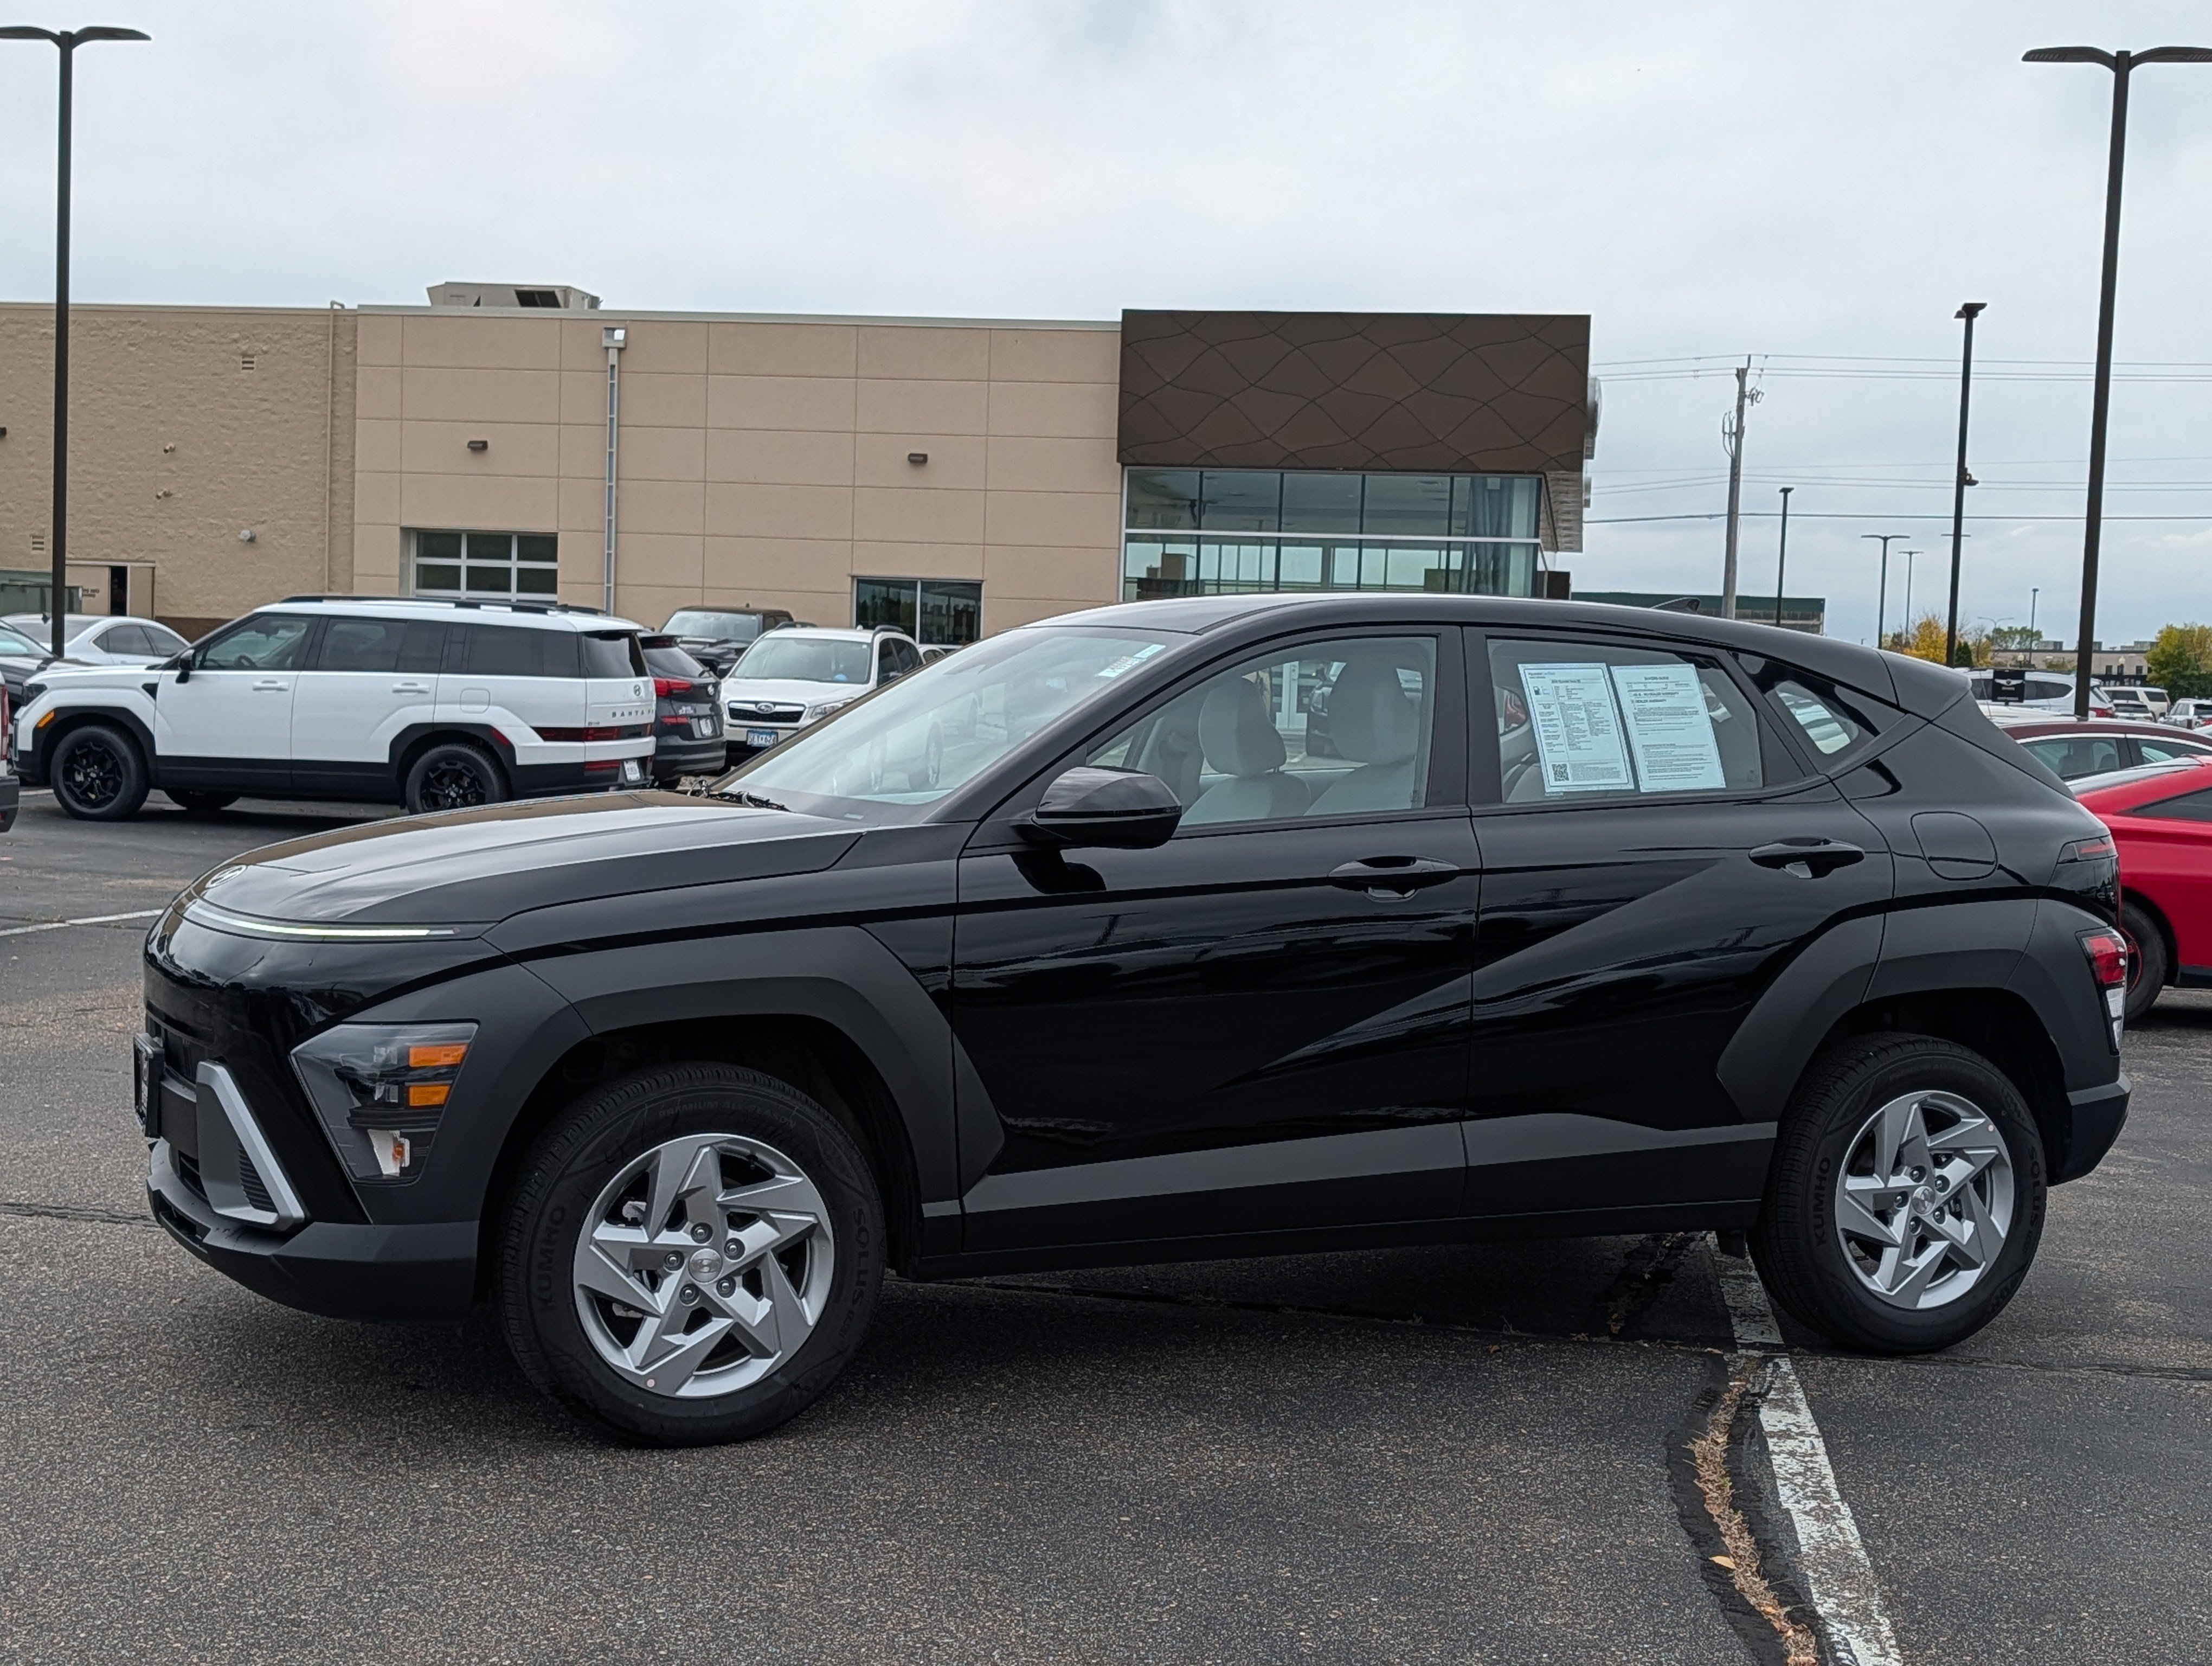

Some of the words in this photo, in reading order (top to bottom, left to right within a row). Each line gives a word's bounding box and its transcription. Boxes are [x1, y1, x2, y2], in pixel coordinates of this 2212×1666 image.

[1812, 1157, 1831, 1247] KUMHO
[2028, 1145, 2041, 1227] SOLUS
[536, 1205, 567, 1313] KUMHO
[852, 1207, 870, 1306] SOLUS
